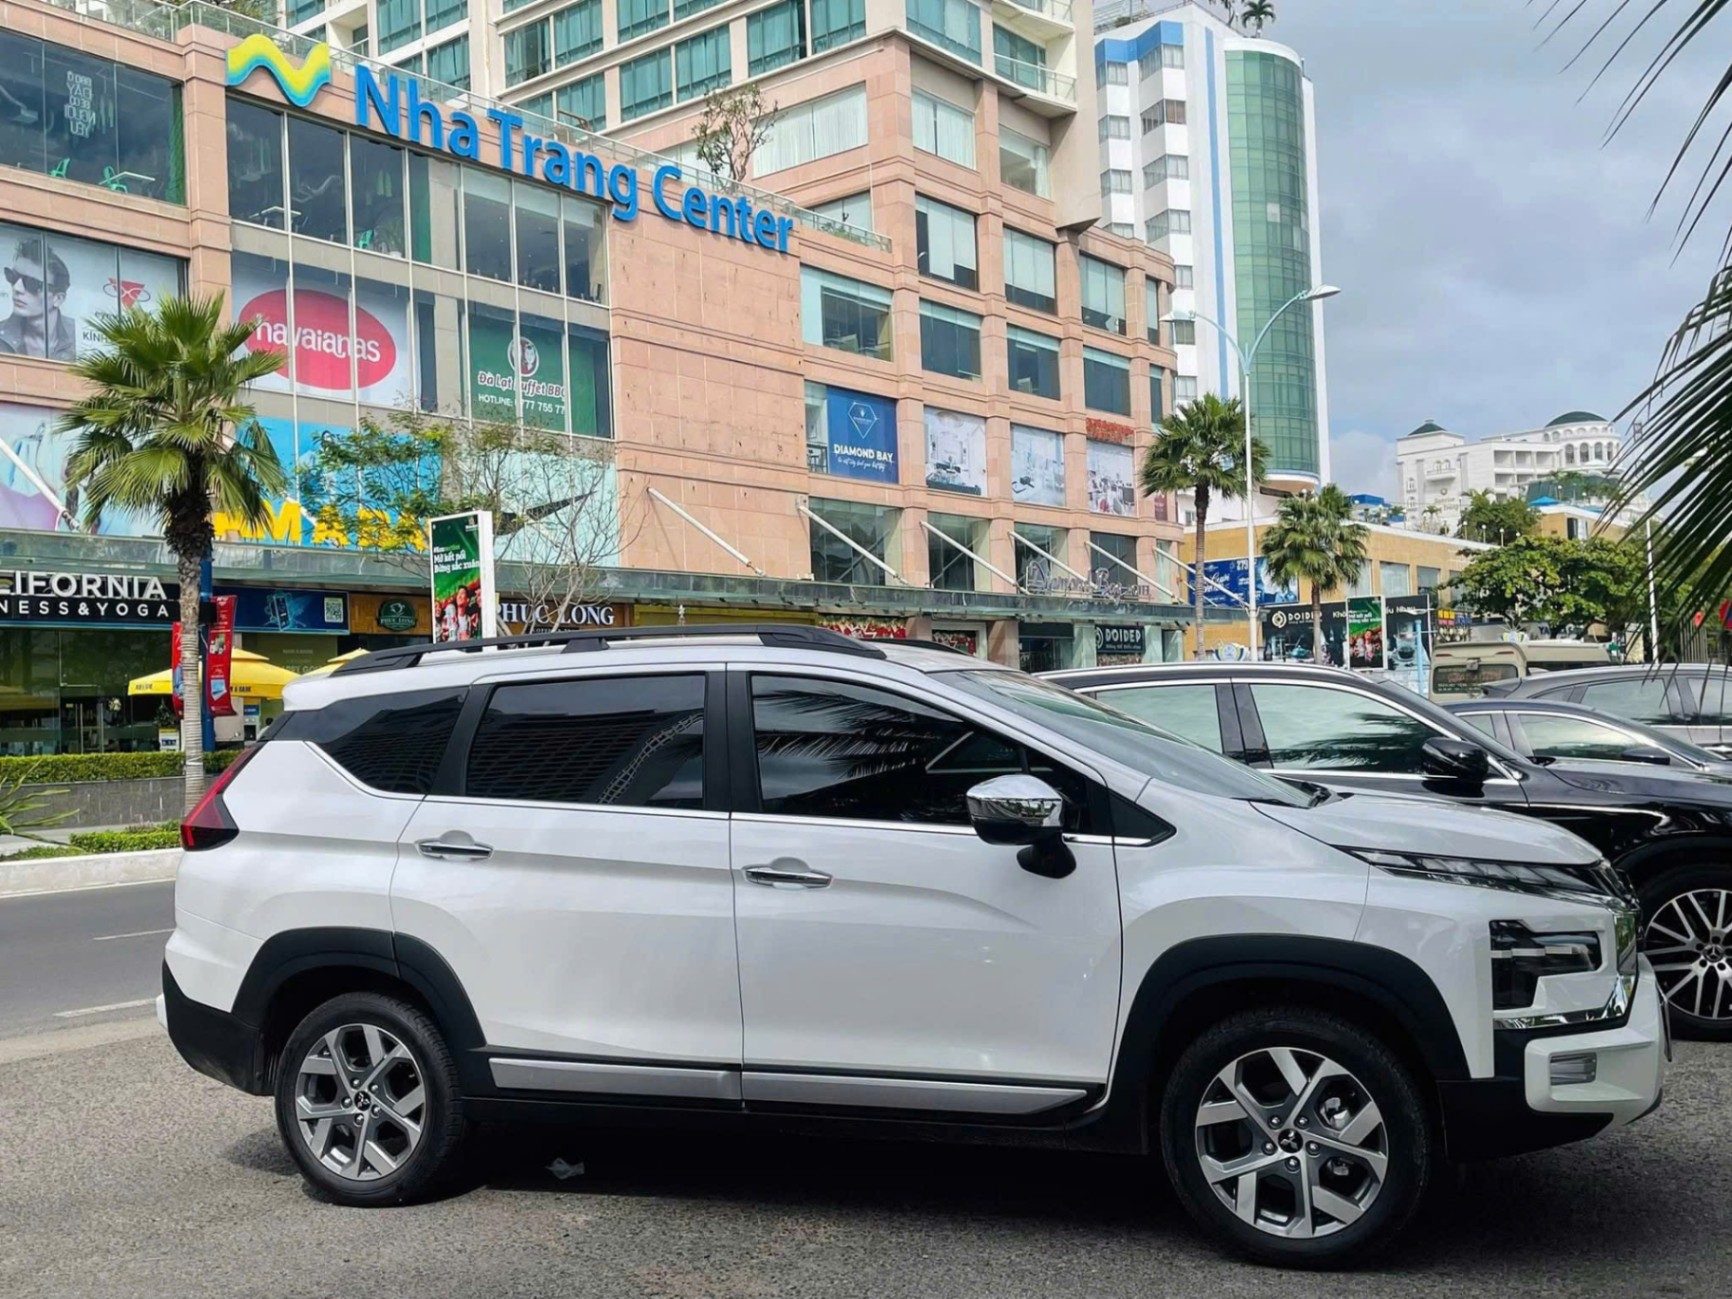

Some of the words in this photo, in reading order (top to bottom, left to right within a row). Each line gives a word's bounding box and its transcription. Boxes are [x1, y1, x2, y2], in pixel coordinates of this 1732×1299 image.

[354, 63, 480, 162] Nha
[486, 106, 640, 223] Trang
[651, 163, 794, 253] Center
[514, 377, 546, 397] uffet
[833, 444, 875, 459] DIAMOND
[876, 450, 893, 464] BAY
